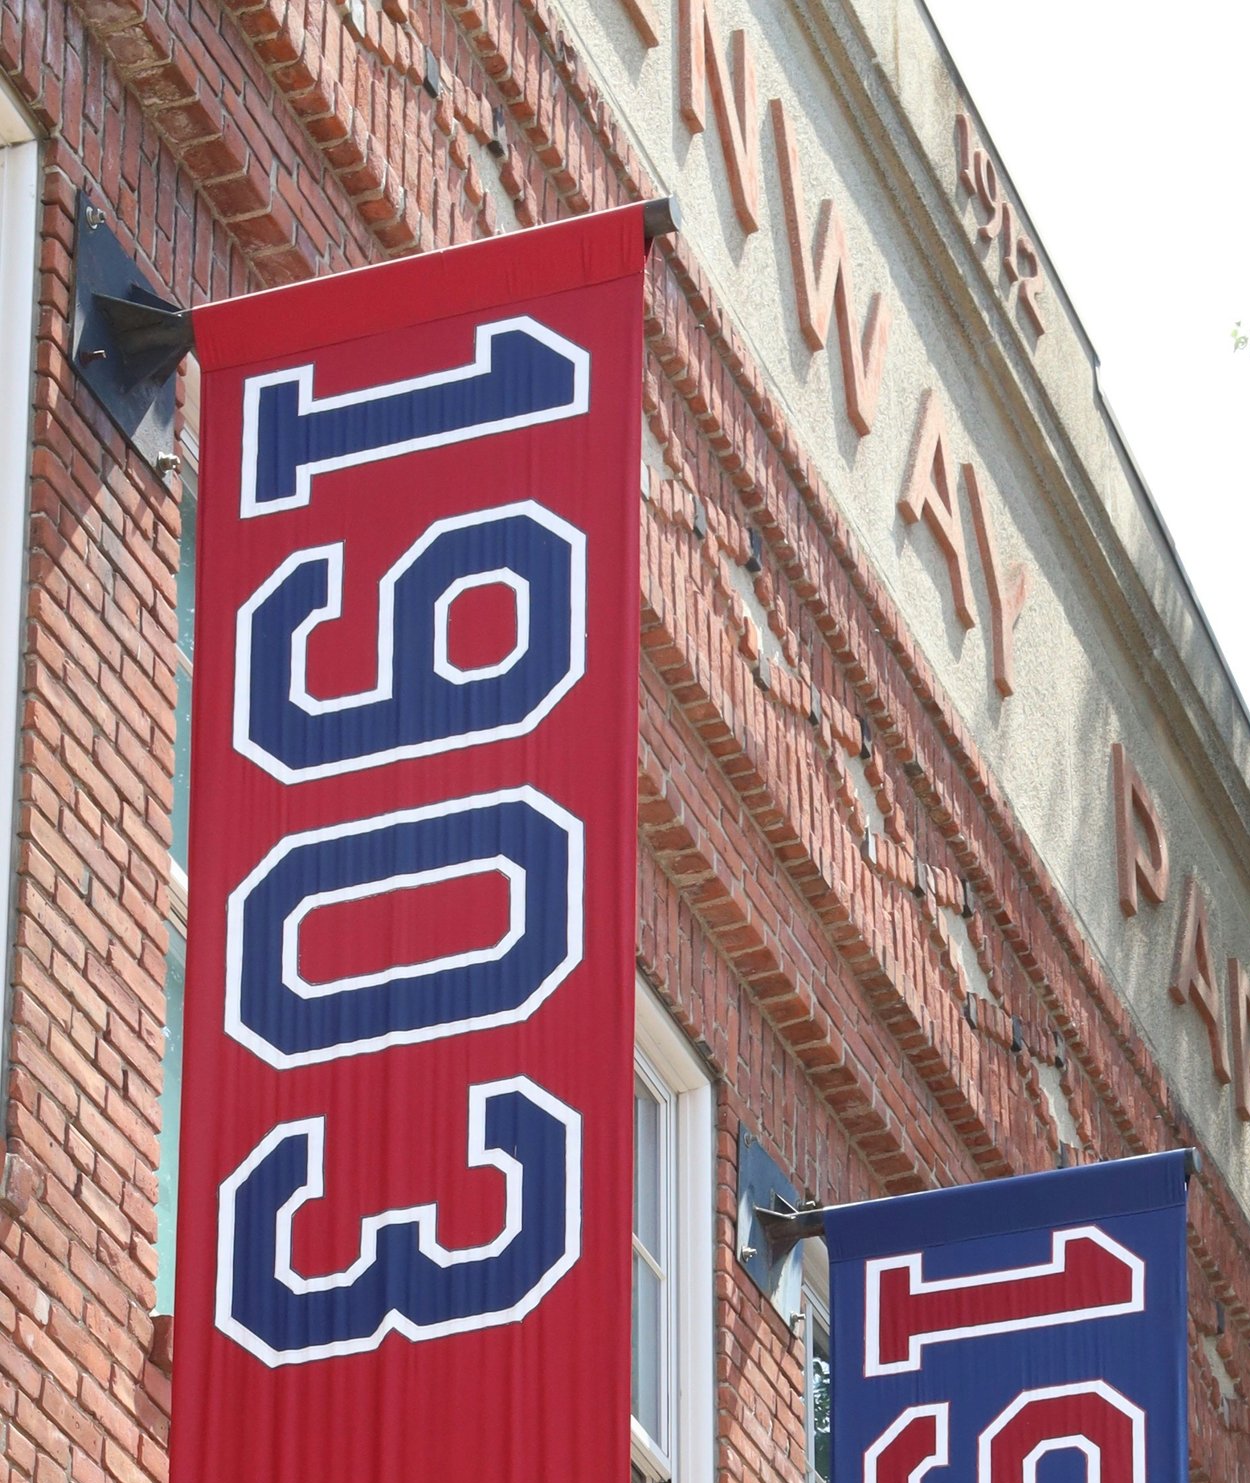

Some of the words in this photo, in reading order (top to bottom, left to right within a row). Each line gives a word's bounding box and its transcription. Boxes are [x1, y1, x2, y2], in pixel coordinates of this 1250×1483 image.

[622, 0, 1028, 697] NWAY
[956, 113, 1046, 337] 1912
[215, 315, 590, 1368] 1903
